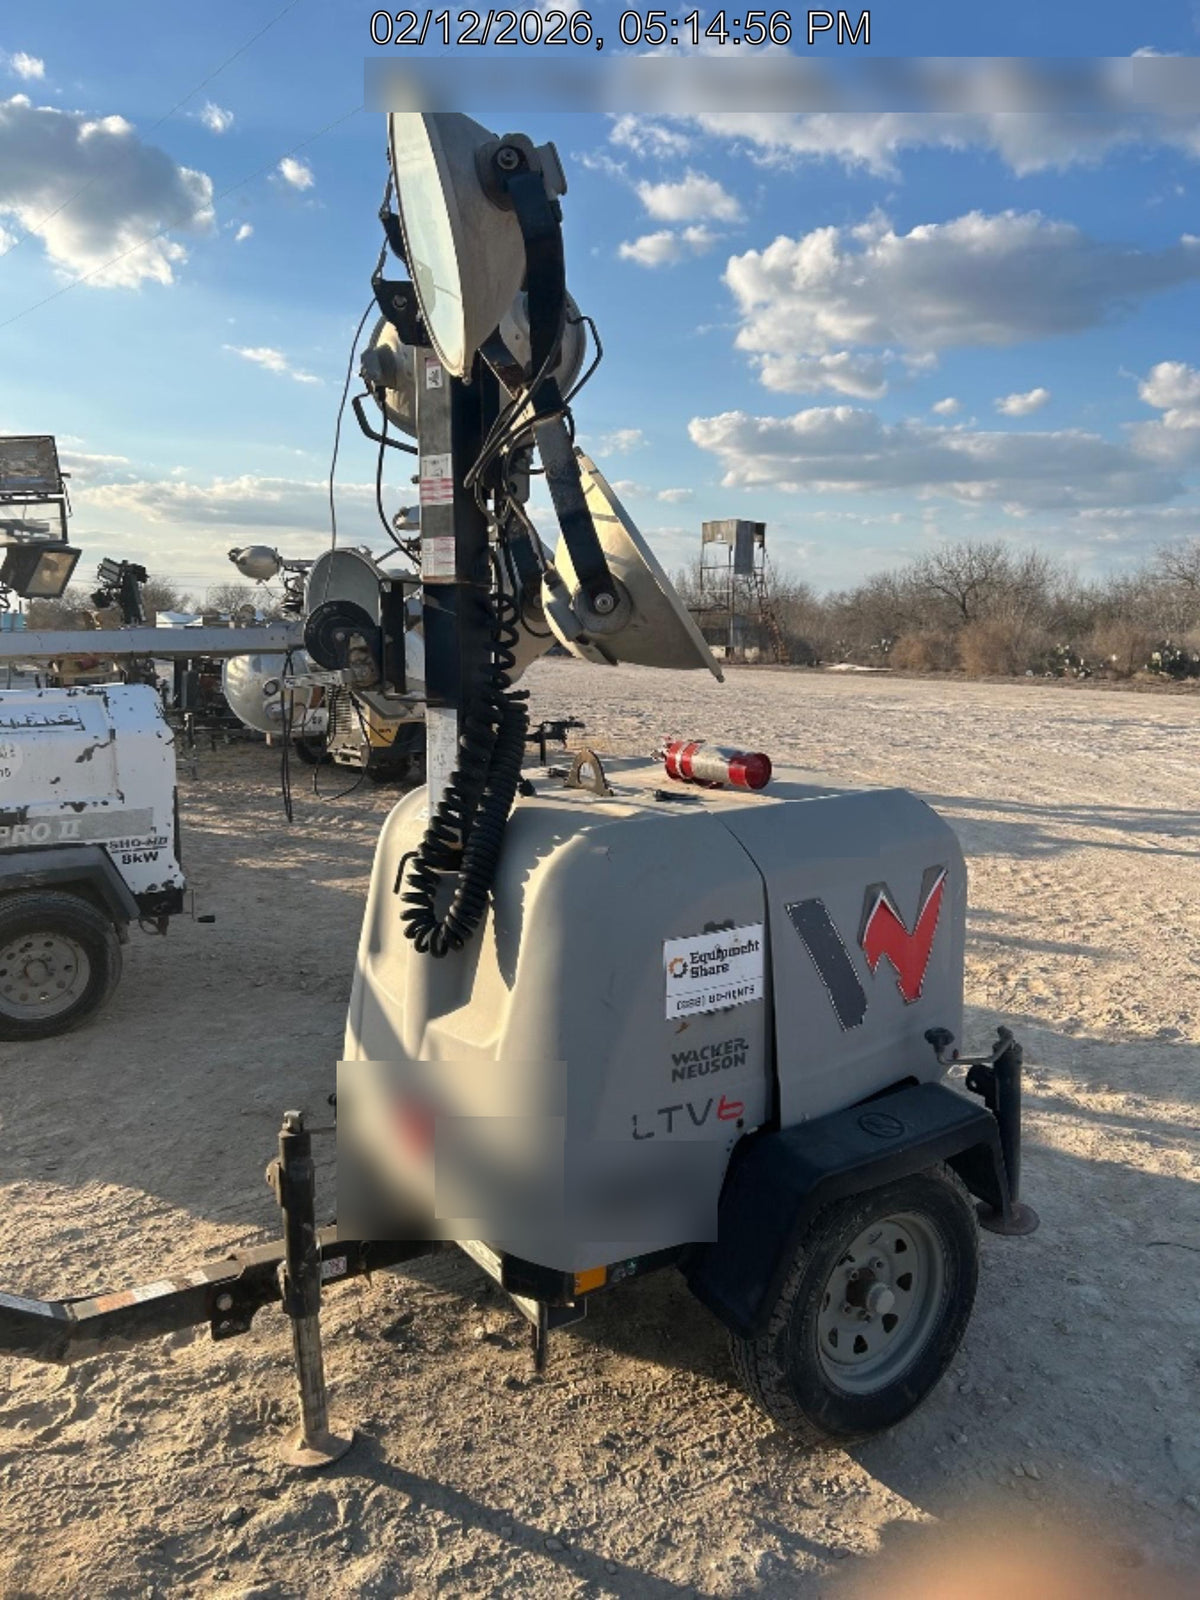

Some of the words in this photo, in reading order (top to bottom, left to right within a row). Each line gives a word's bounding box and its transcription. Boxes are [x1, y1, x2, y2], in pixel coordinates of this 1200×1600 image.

[122, 851, 159, 864] 8kW
[690, 963, 730, 978] Share
[671, 1038, 749, 1066] WACKER
[671, 1052, 746, 1083] NEUSON
